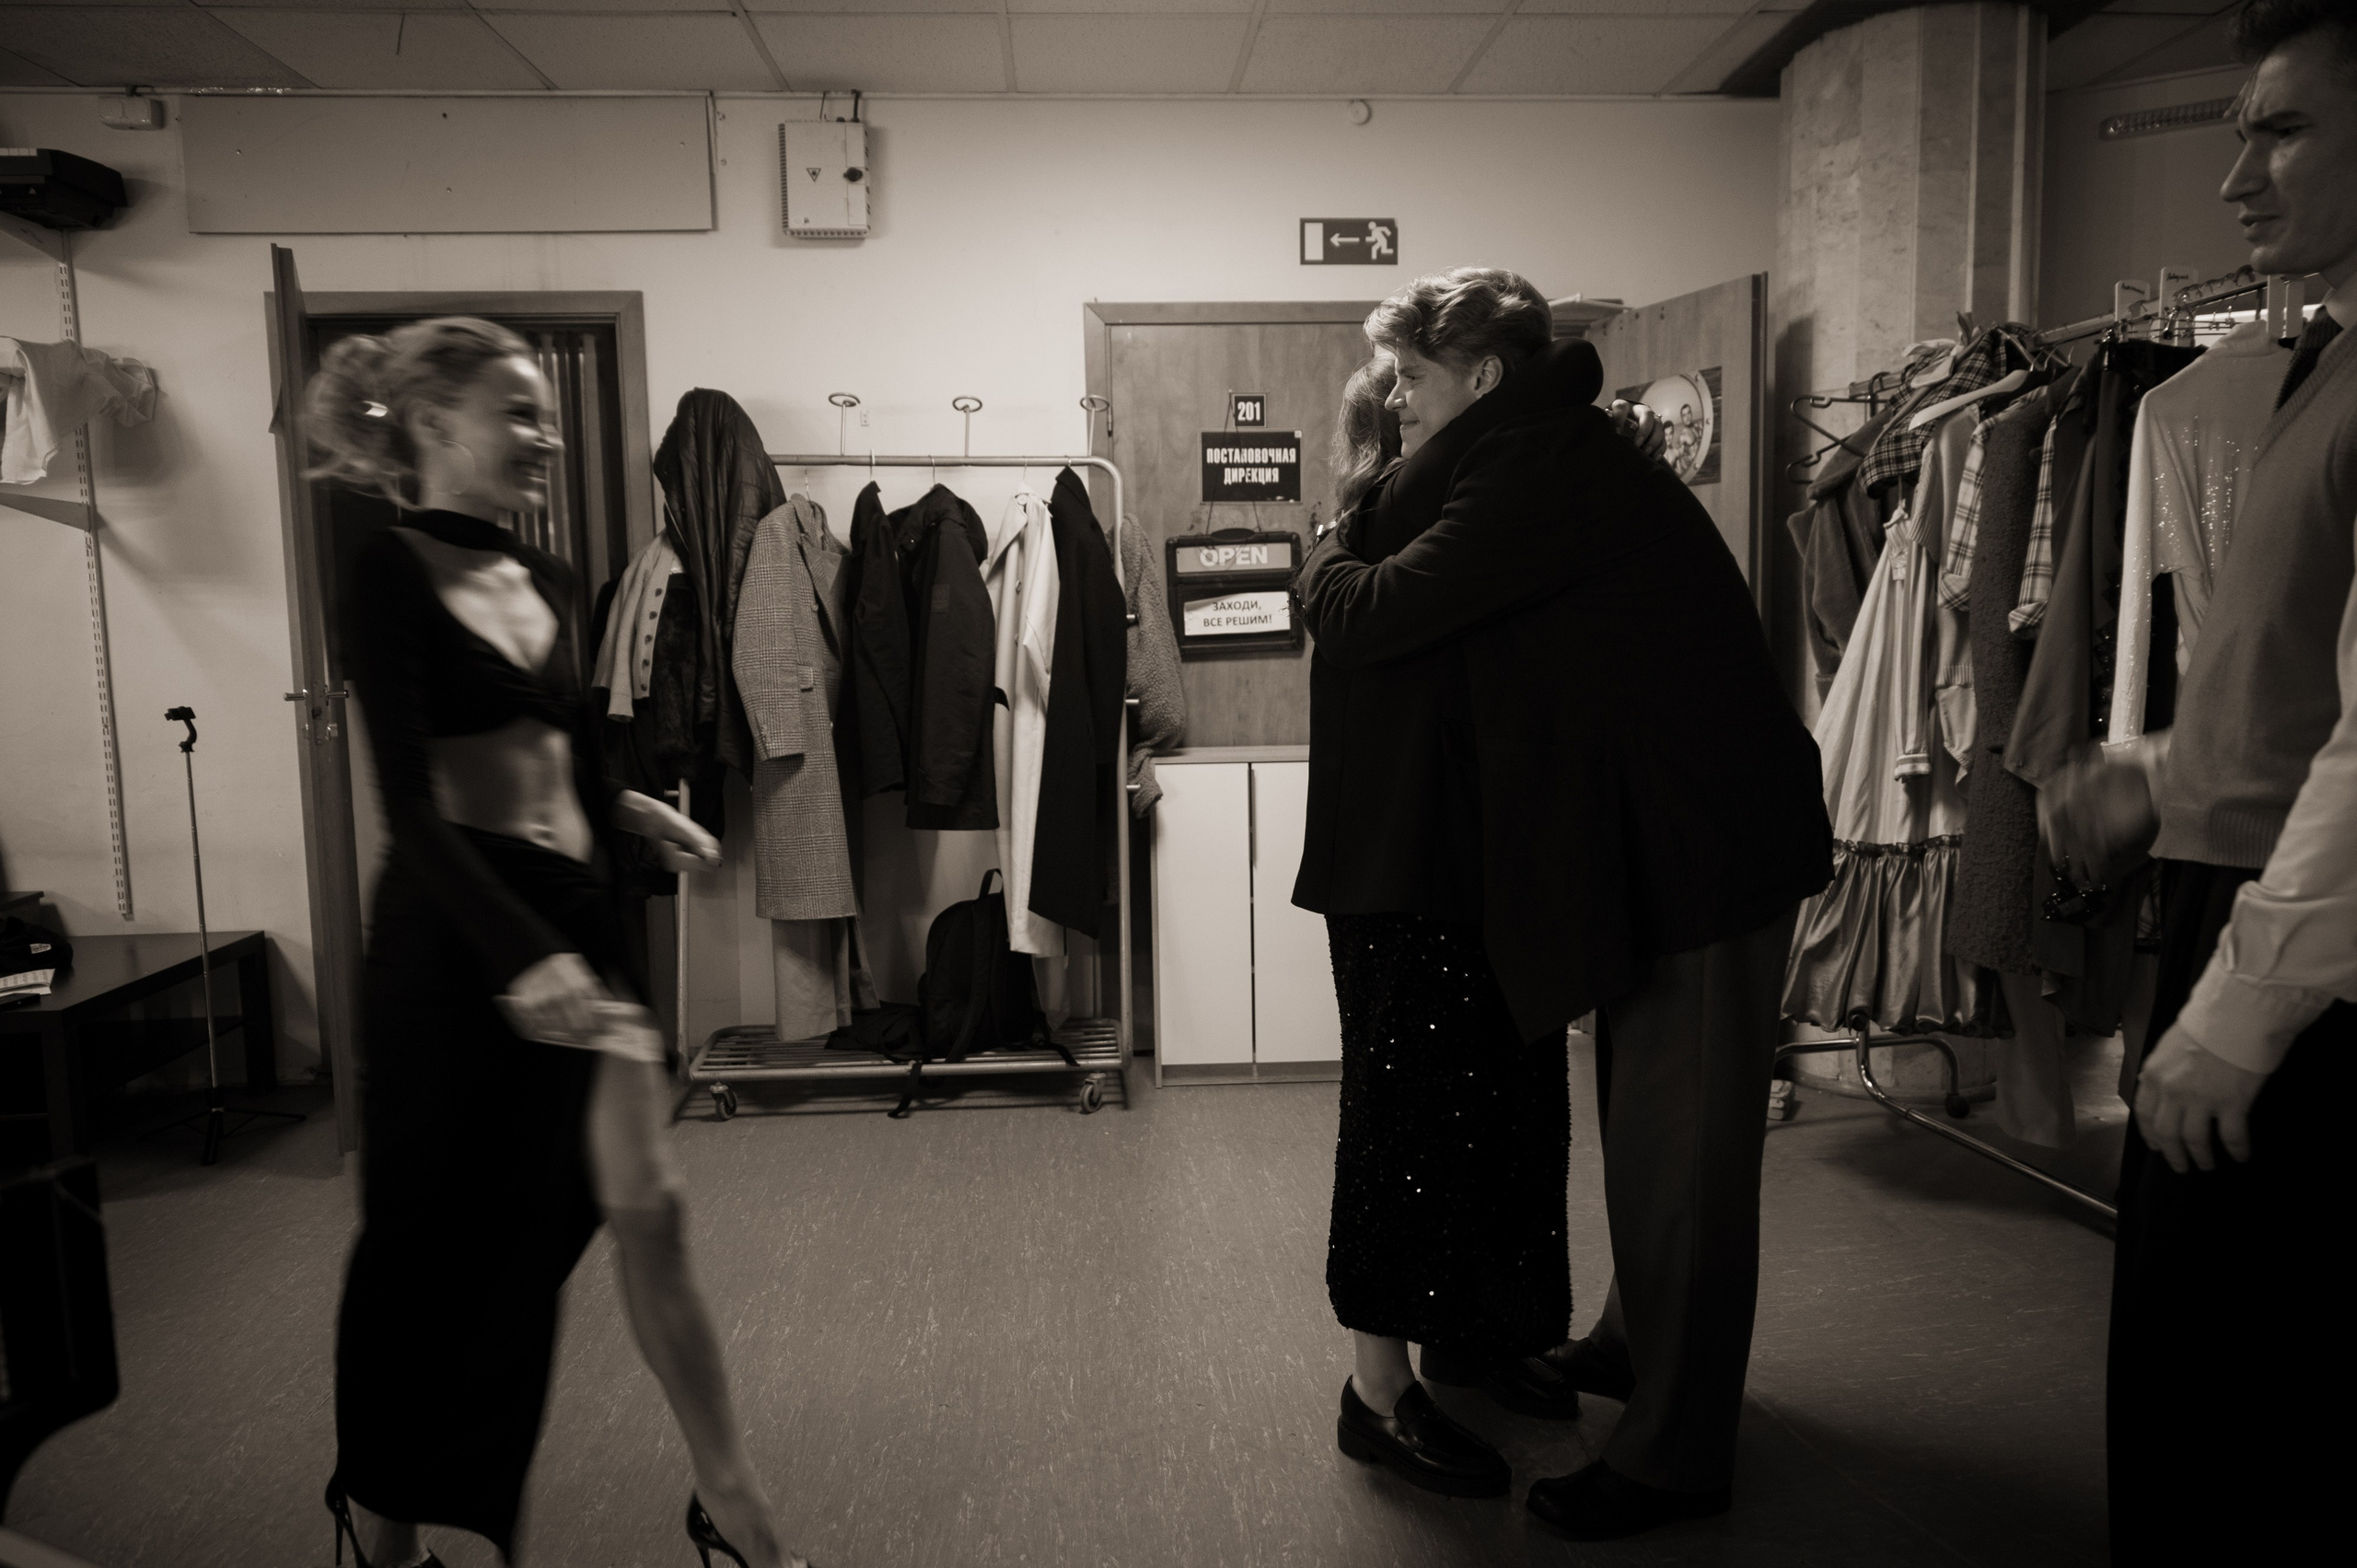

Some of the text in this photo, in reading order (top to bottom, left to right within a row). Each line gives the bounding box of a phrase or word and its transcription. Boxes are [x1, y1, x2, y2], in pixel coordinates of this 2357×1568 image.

[1237, 401, 1260, 421] 201
[1206, 447, 1296, 464] ПОСТАНОВОЧНАЯ
[1224, 467, 1280, 485] ДИРЕКЦИЯ
[1200, 546, 1268, 566] OPEN
[1213, 600, 1261, 611] ЗАХОДИ,
[1203, 614, 1272, 627] ВСЕ РЕШИМ!
